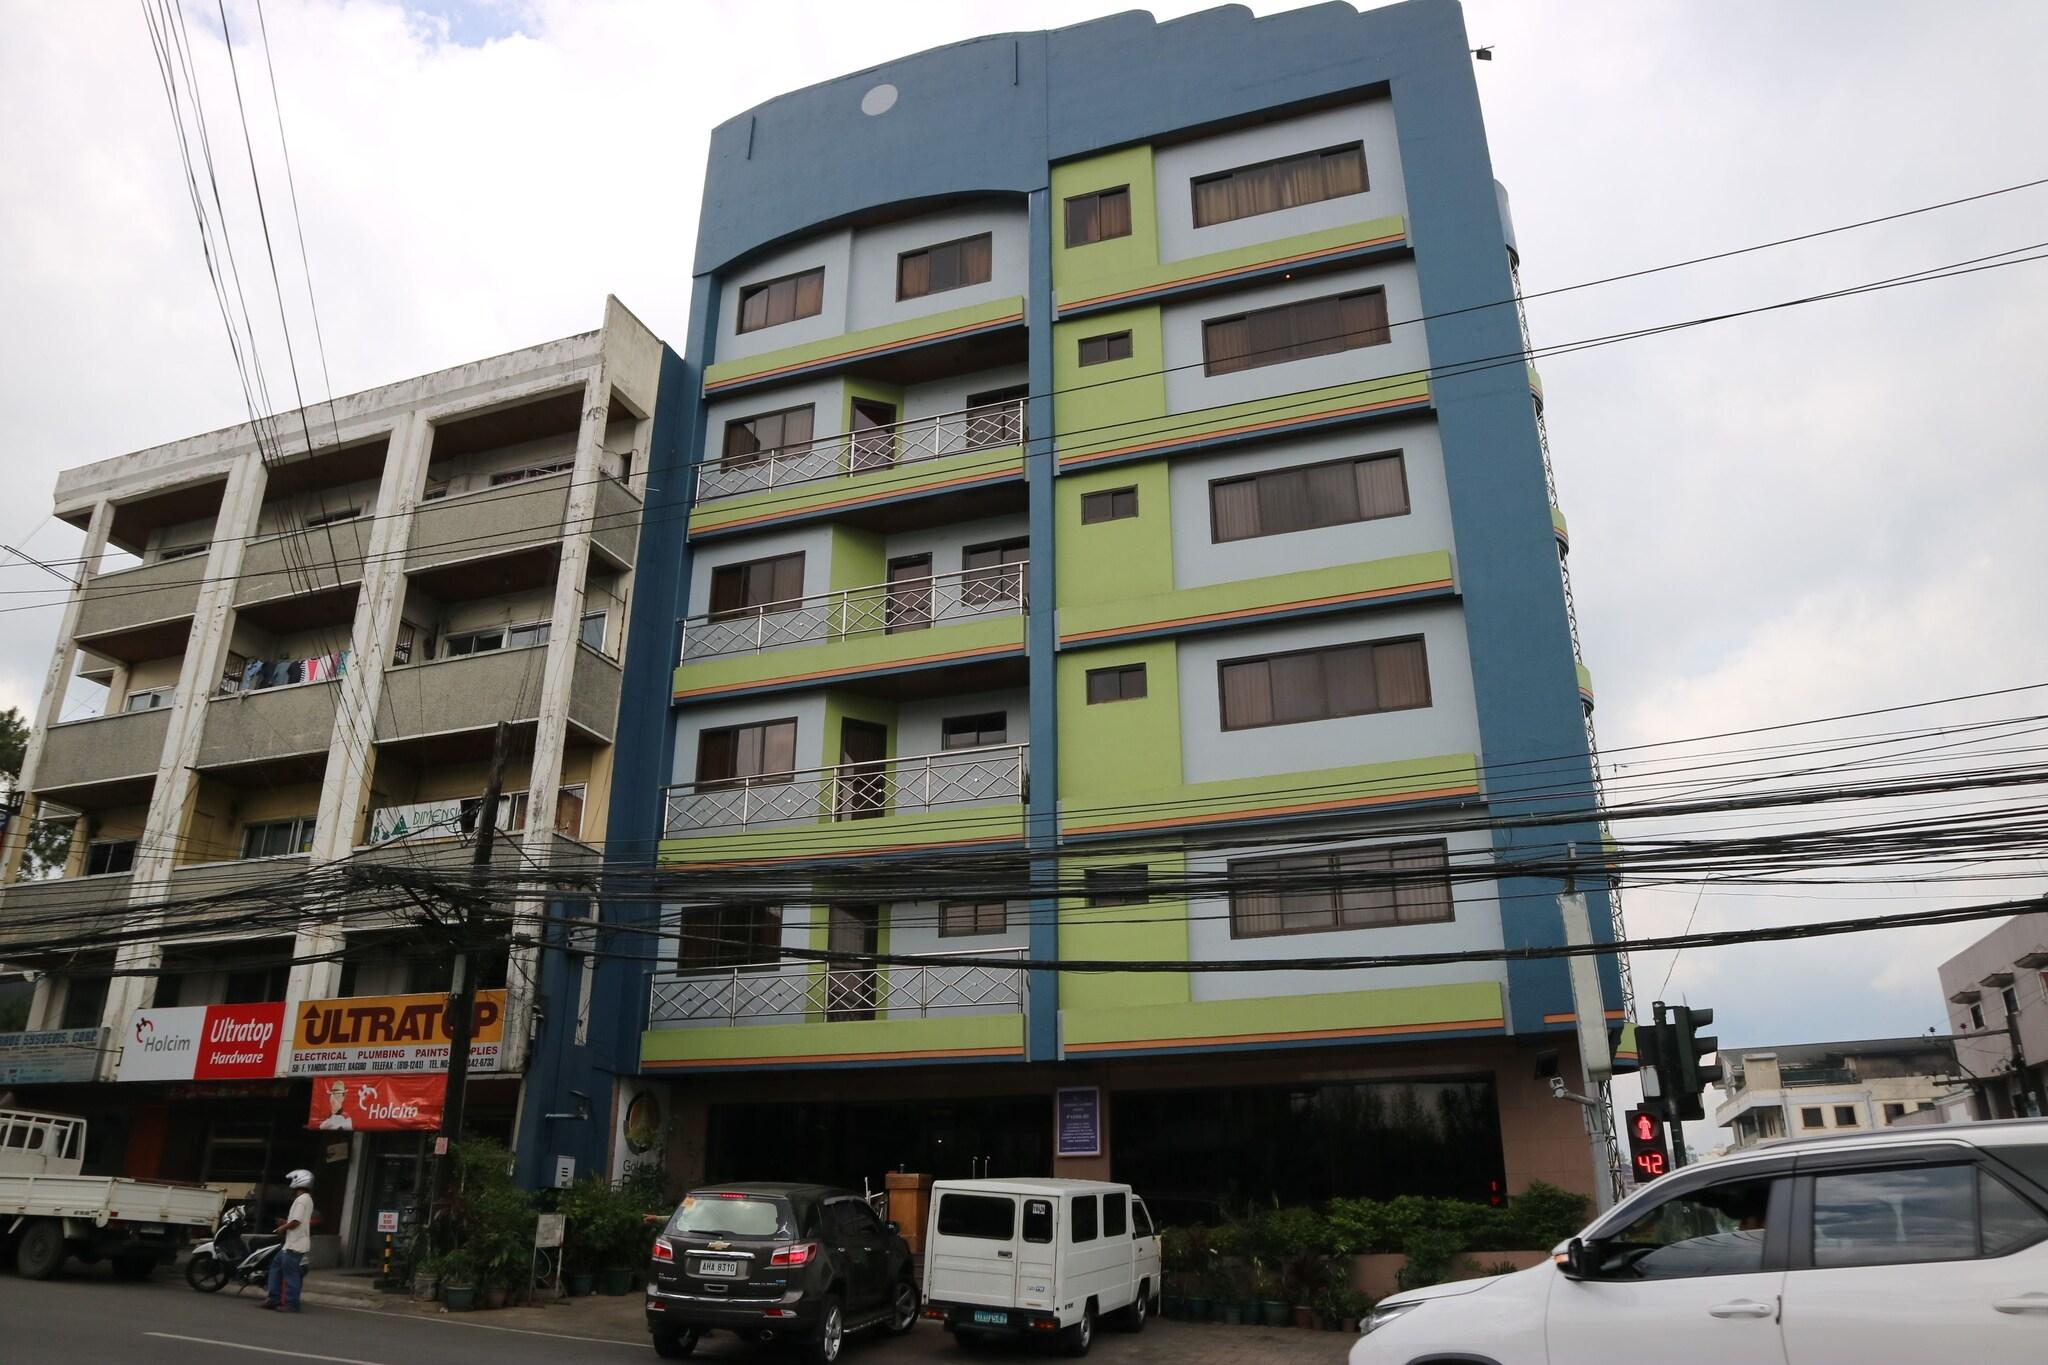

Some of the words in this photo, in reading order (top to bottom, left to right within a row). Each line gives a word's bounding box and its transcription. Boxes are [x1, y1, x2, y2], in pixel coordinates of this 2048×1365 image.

[209, 1017, 275, 1048] Ultratop
[303, 1001, 499, 1046] ULTRATP
[143, 1034, 191, 1053] Holcim
[209, 1050, 264, 1066] Hardware
[293, 1049, 348, 1062] ELECTRICAL
[357, 1048, 406, 1061] PLUMBING
[414, 1046, 450, 1058] PAINTS
[368, 1102, 419, 1120] Holcim
[1638, 1153, 1665, 1175] 42
[702, 1261, 715, 1272] AHA
[717, 1262, 736, 1274] 8310
